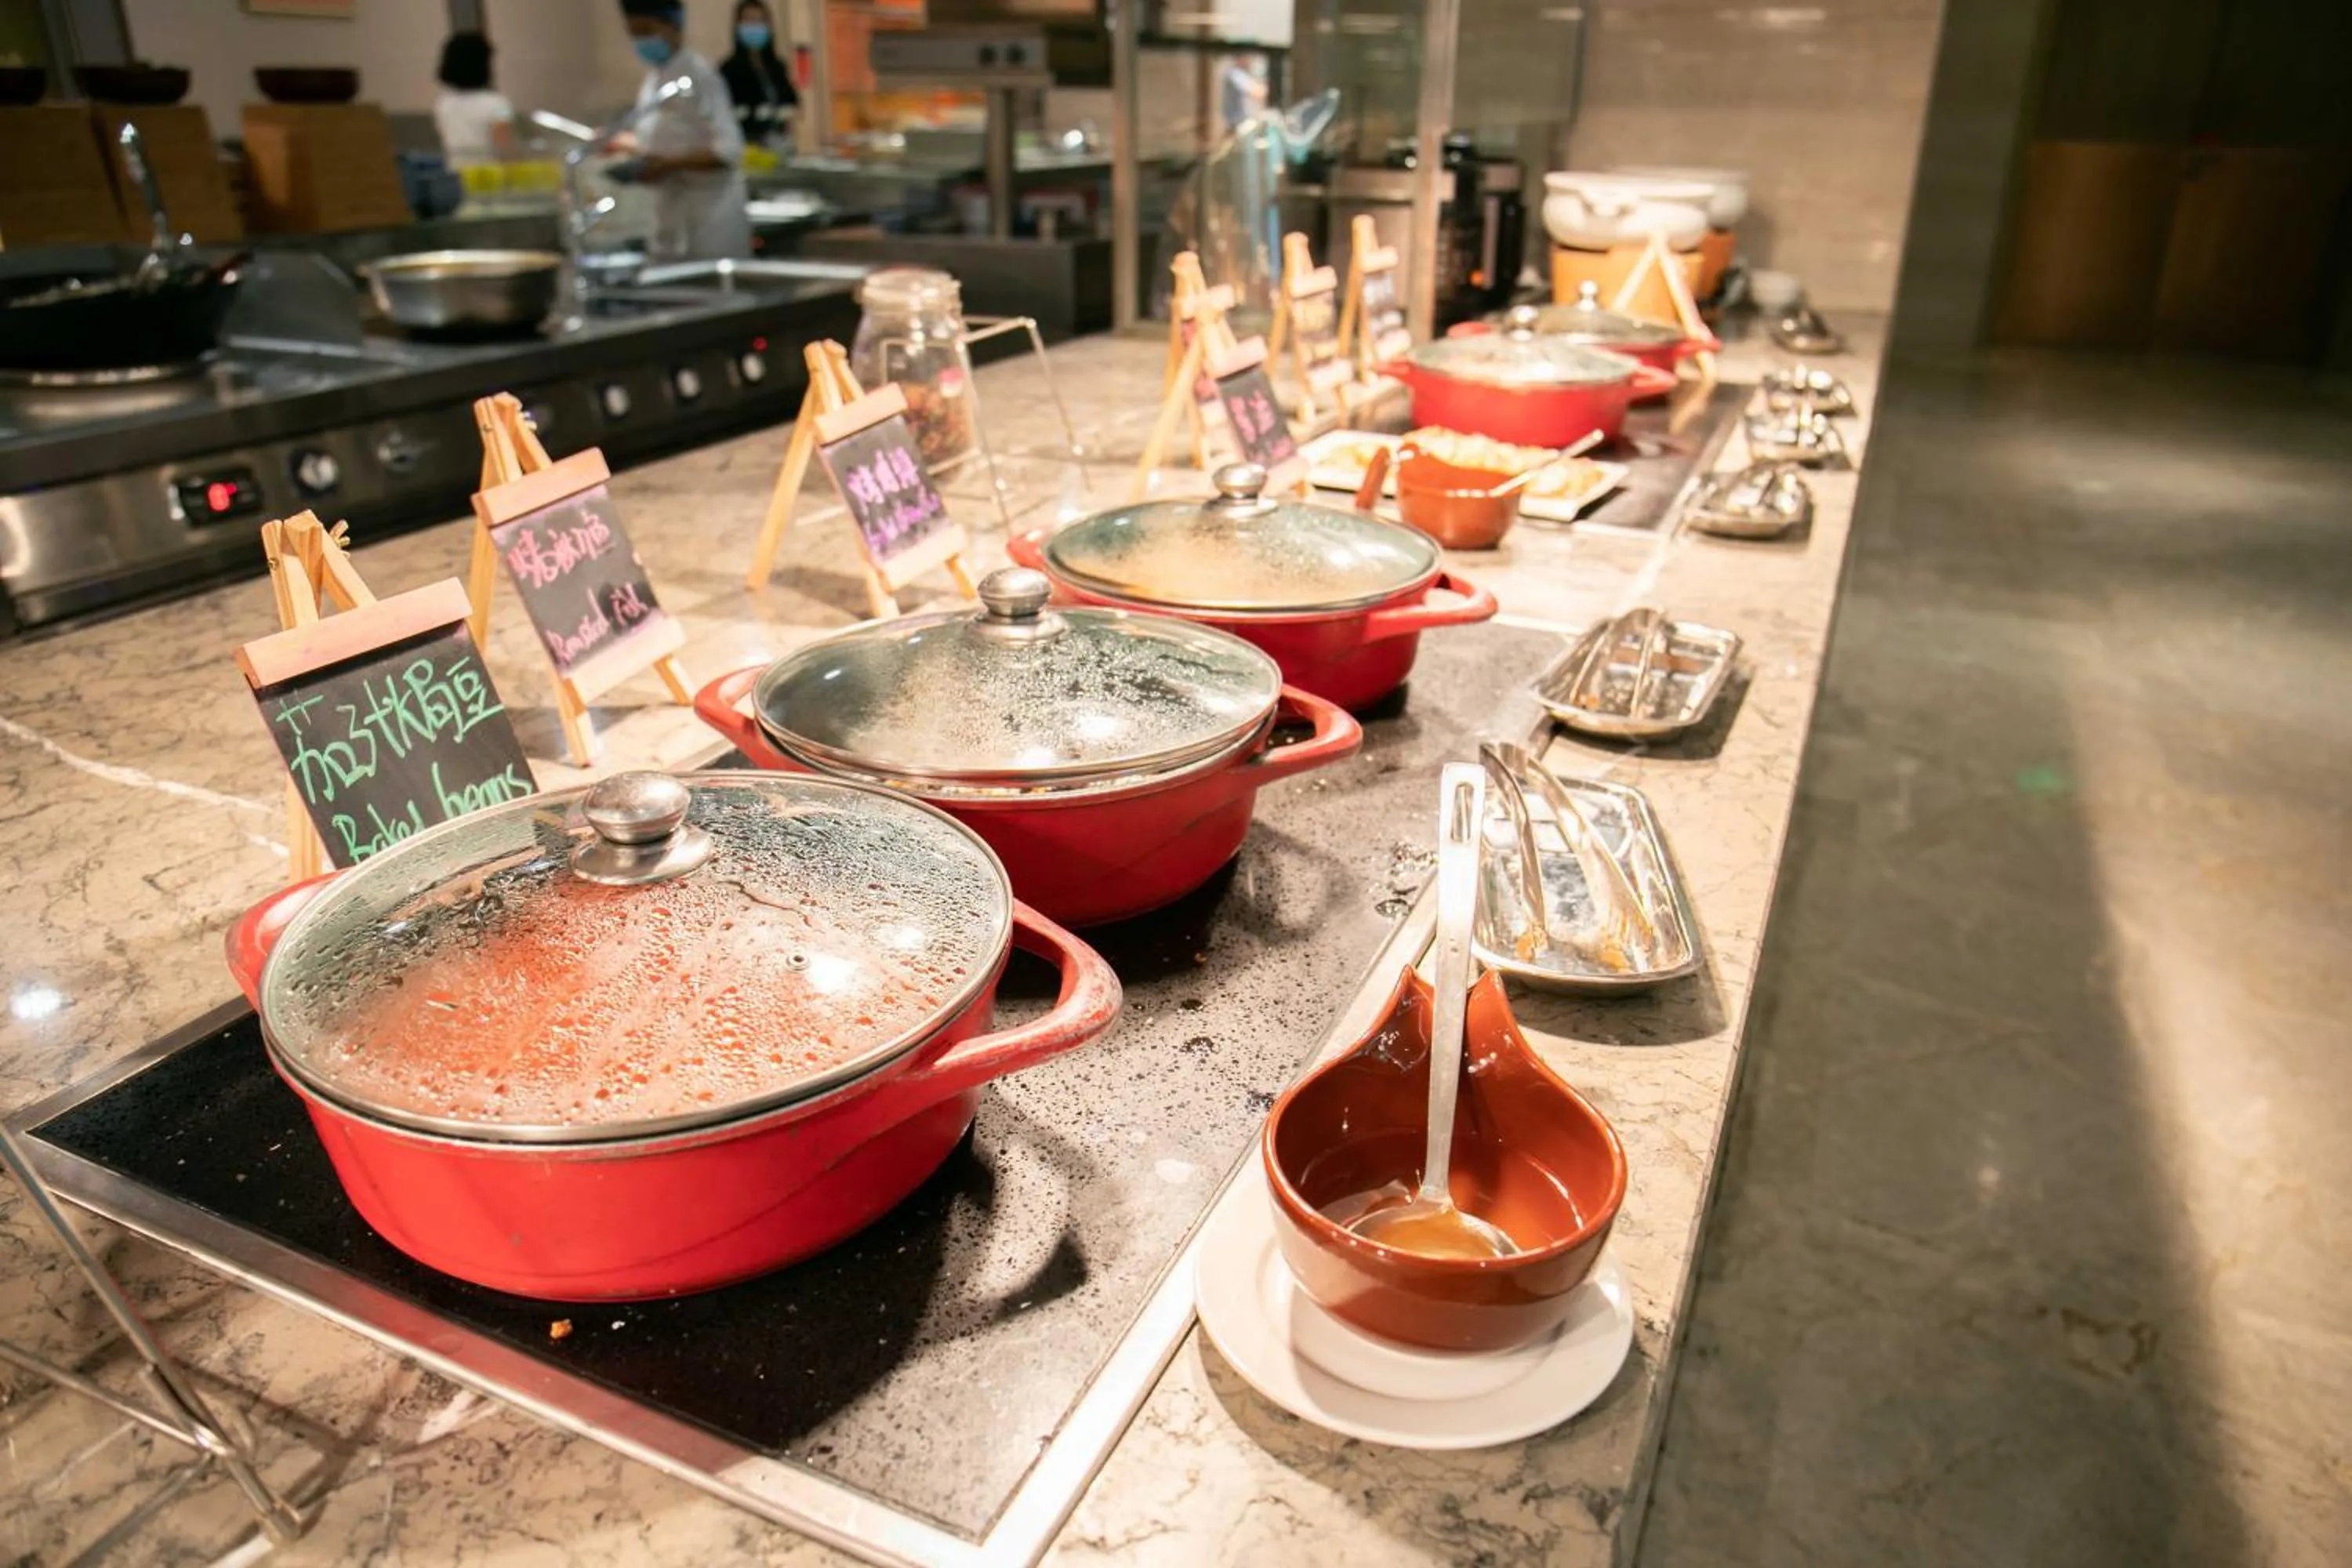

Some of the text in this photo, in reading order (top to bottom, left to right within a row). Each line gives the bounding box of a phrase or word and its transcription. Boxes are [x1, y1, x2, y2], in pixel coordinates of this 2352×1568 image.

[275, 656, 506, 804] 茄汁焗豆
[331, 761, 534, 864] Baked beans
